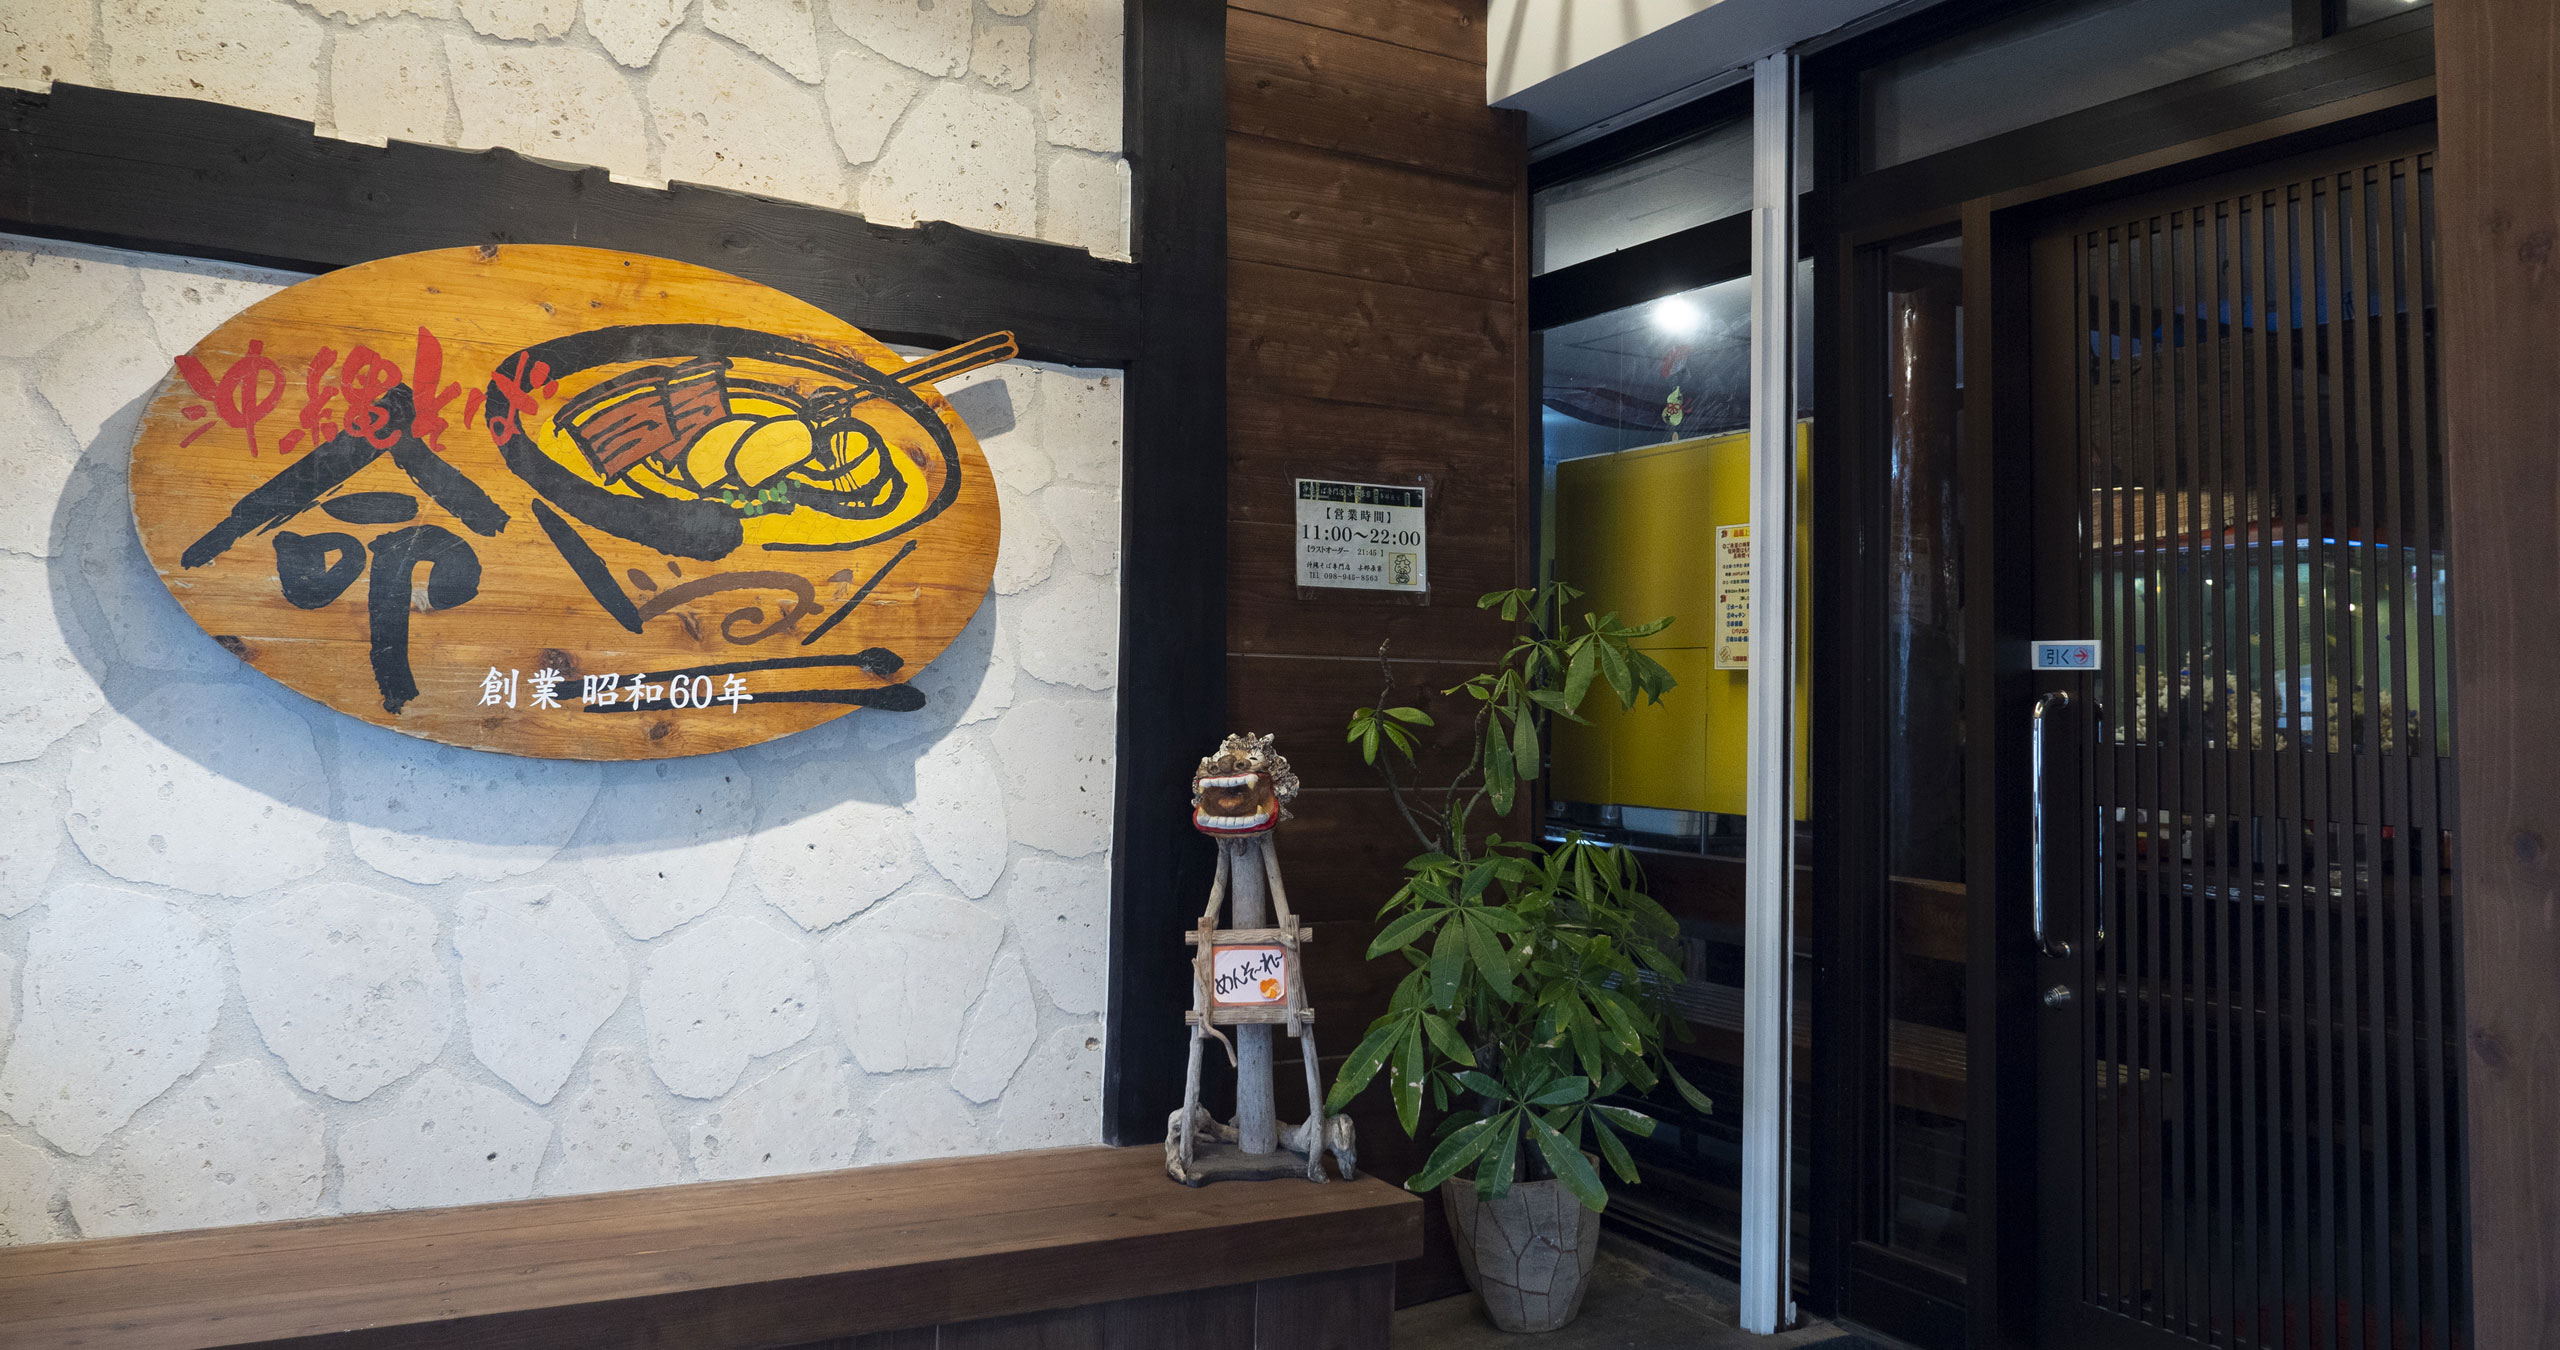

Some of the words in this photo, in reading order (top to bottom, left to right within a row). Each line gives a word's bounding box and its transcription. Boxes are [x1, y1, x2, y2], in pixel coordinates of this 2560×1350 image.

[174, 326, 559, 457] 沖縄そば
[180, 383, 511, 714] 命
[2046, 648, 2069, 665] 引く
[477, 666, 566, 710] 創業
[581, 672, 754, 714] 昭和60年
[1215, 952, 1283, 995] めんそーれー
